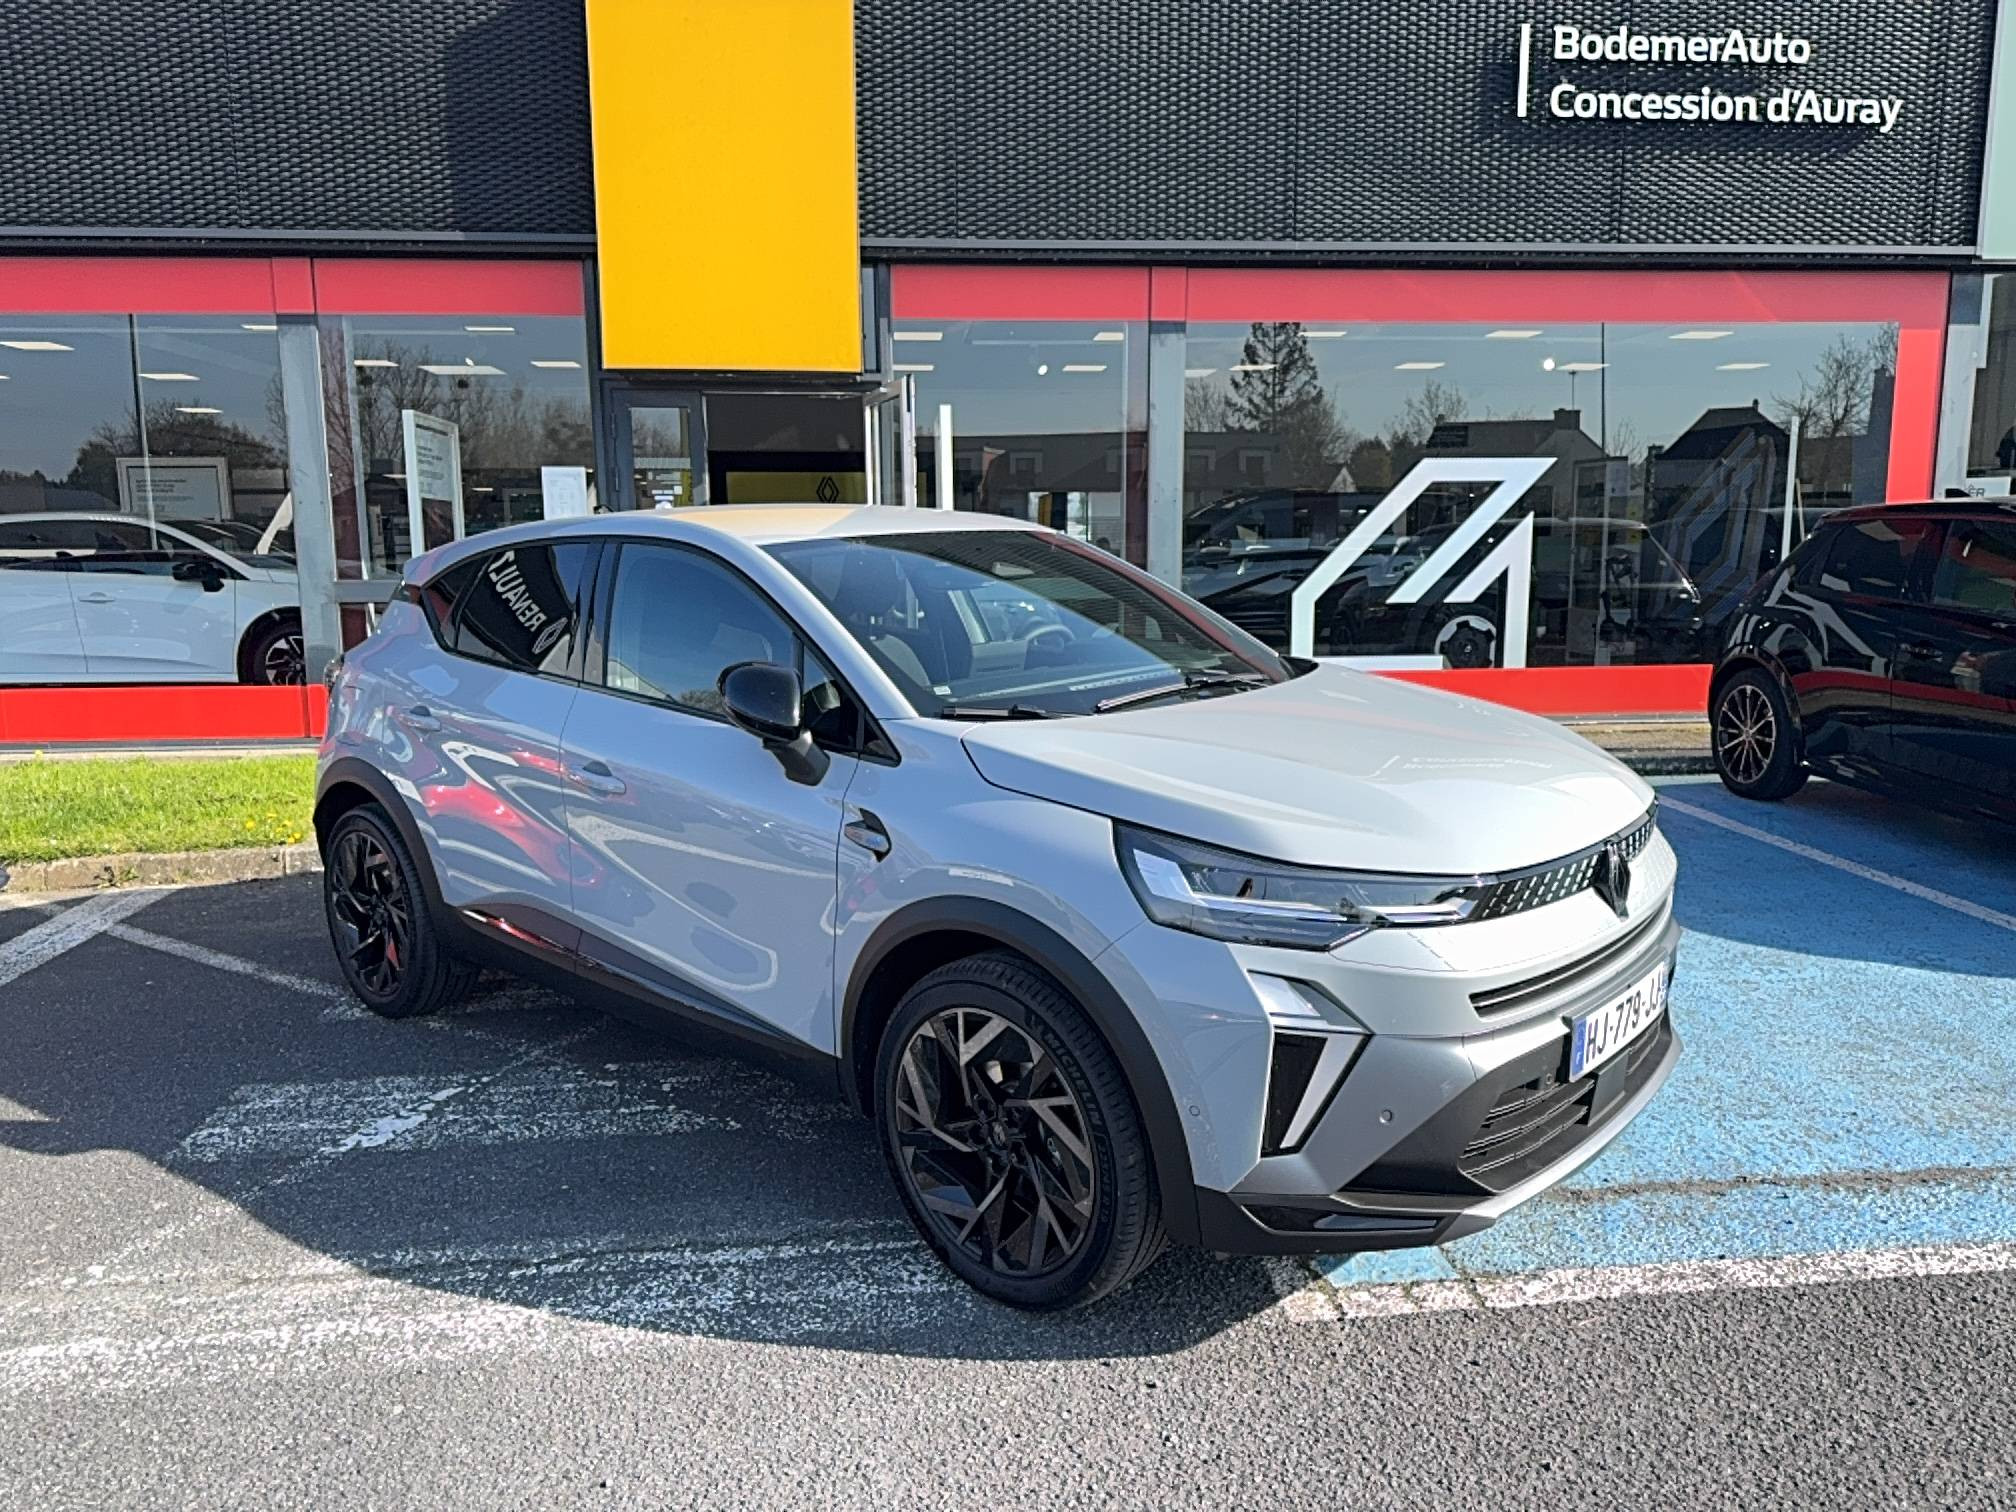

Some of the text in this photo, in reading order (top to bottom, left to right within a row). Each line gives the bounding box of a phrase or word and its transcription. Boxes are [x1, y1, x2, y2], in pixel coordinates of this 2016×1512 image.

[1553, 25, 1811, 65] BodemerAuto
[1550, 84, 1902, 134] Concession d'Auray
[1044, 1032, 1104, 1126] MICHELIN
